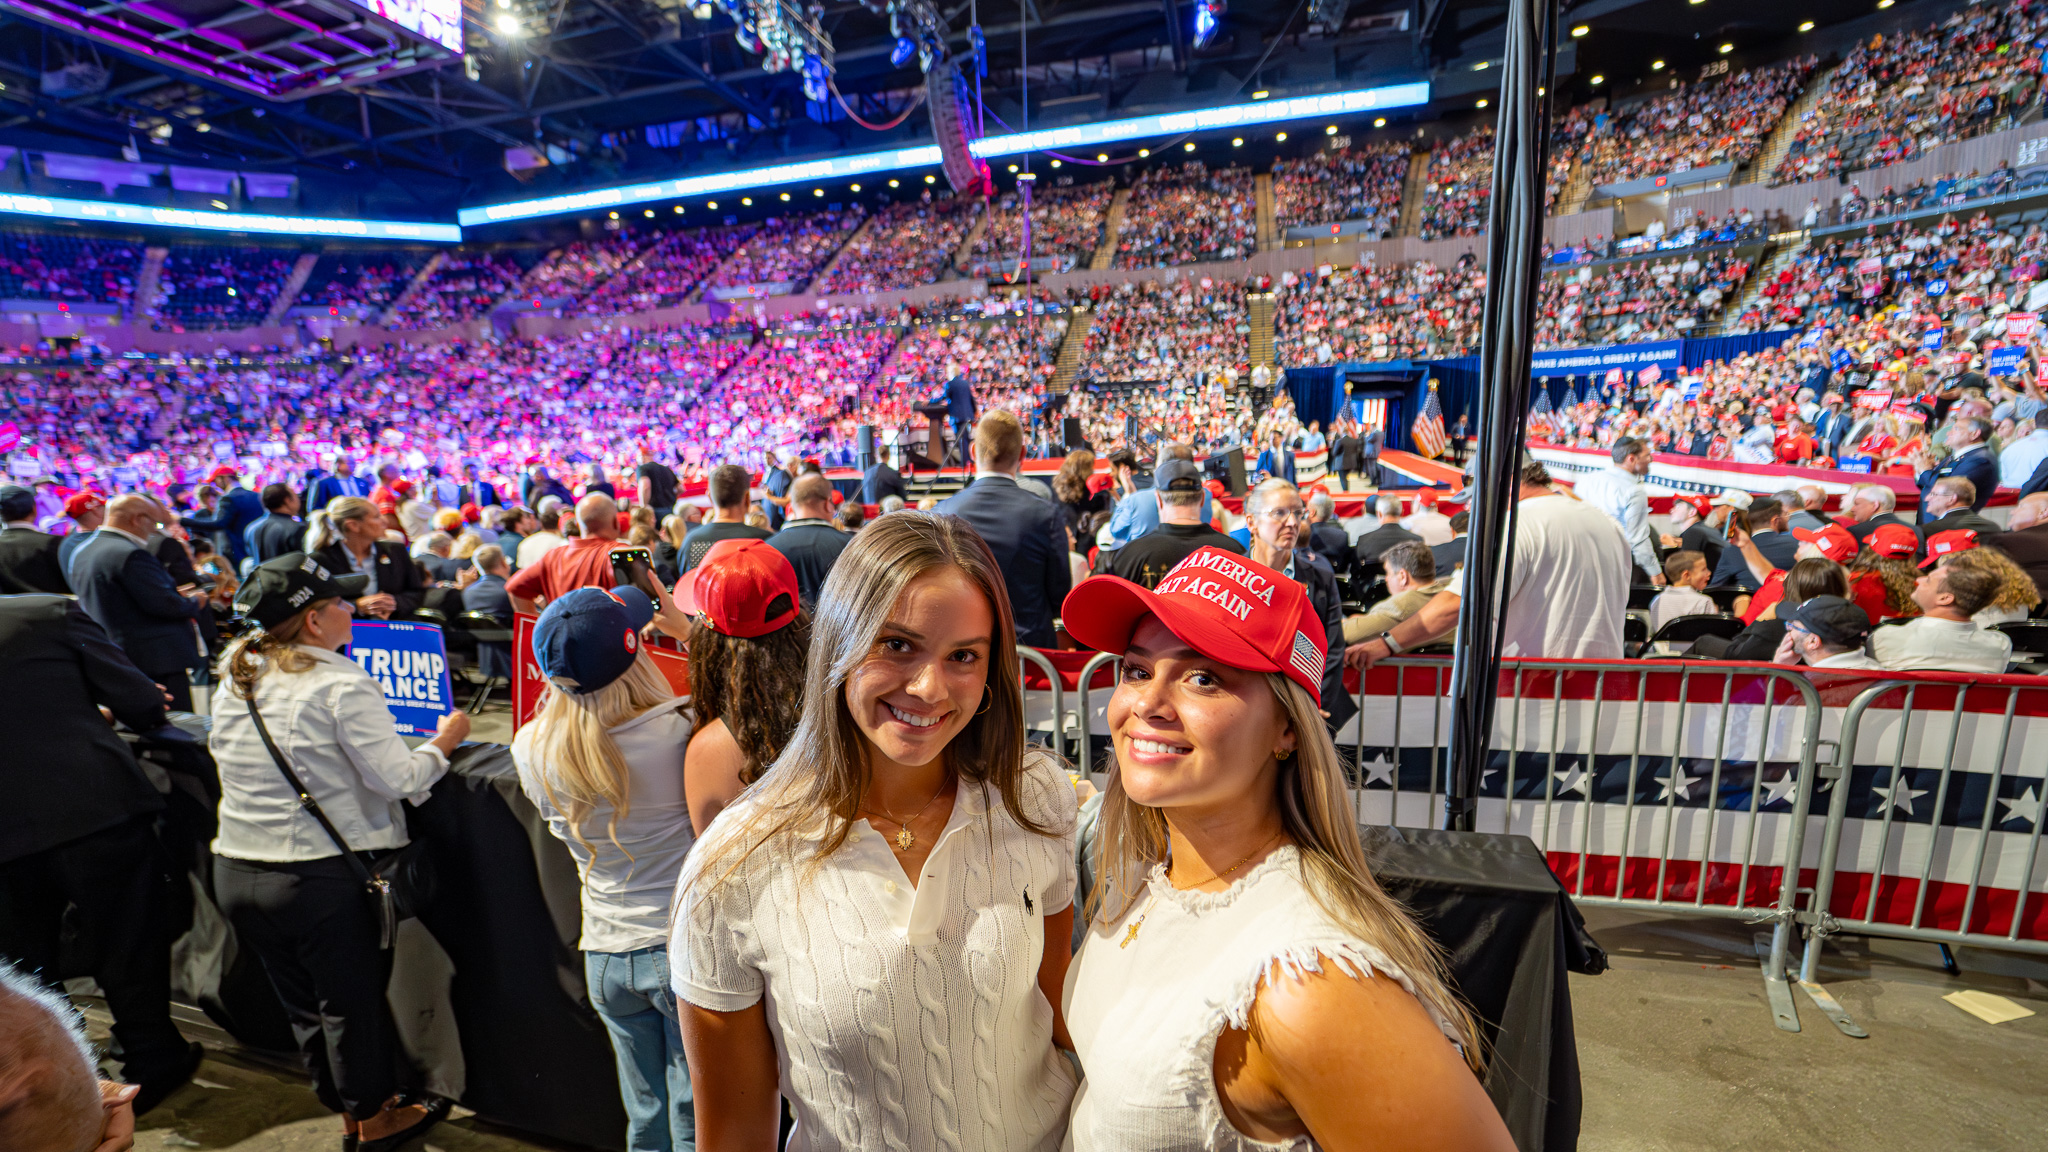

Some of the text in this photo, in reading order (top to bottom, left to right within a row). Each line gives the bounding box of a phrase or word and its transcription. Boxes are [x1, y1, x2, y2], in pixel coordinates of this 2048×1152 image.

[1928, 281, 1946, 293] 47
[1531, 349, 1677, 369] MAKE AMERICA GREAT AGAIN!
[1182, 551, 1276, 607] AMERICA
[288, 586, 315, 608] 2024
[1182, 576, 1255, 622] AGAIN
[352, 647, 445, 680] TRUMP
[386, 697, 405, 707] ERICA
[392, 723, 414, 733] 2024
